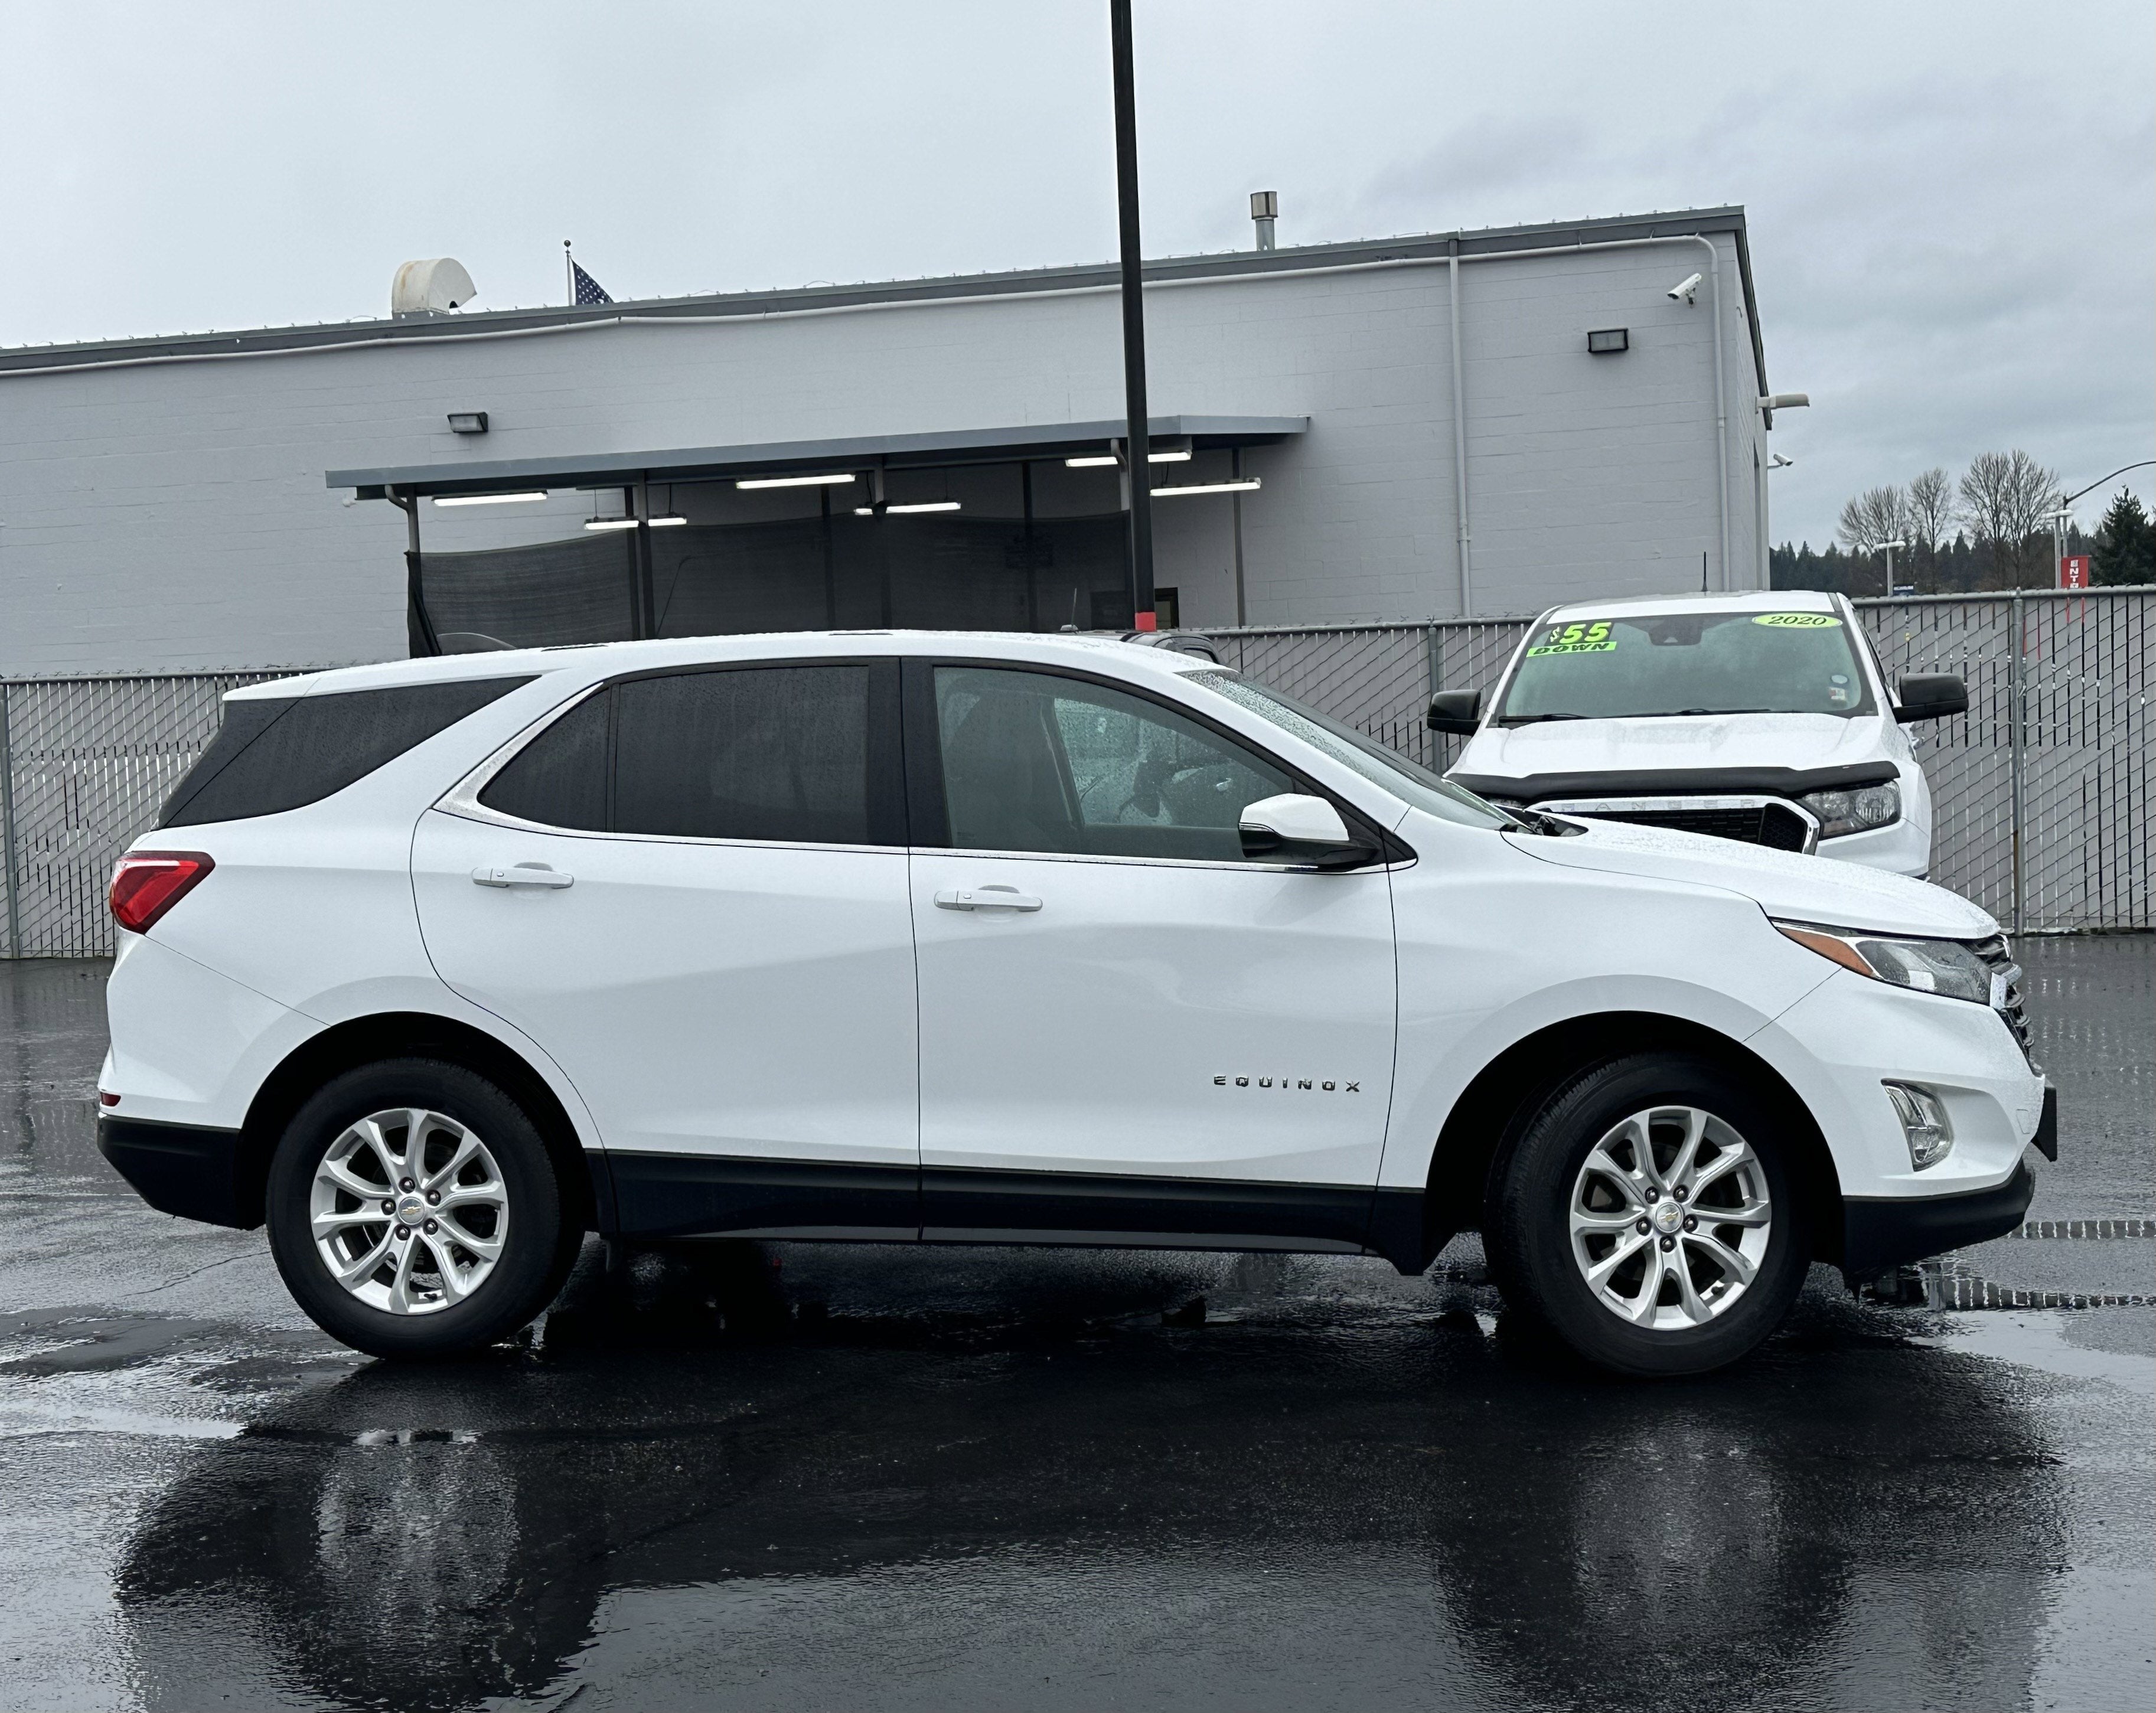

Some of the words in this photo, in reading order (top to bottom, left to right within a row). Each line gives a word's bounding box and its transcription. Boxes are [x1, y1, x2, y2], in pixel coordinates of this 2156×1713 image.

[1767, 616, 1827, 625] 2020
[1550, 622, 1612, 644] $55
[1534, 643, 1610, 655] DOWN
[1561, 799, 1756, 813] RANGER
[1214, 1074, 1360, 1092] EQUINOX
